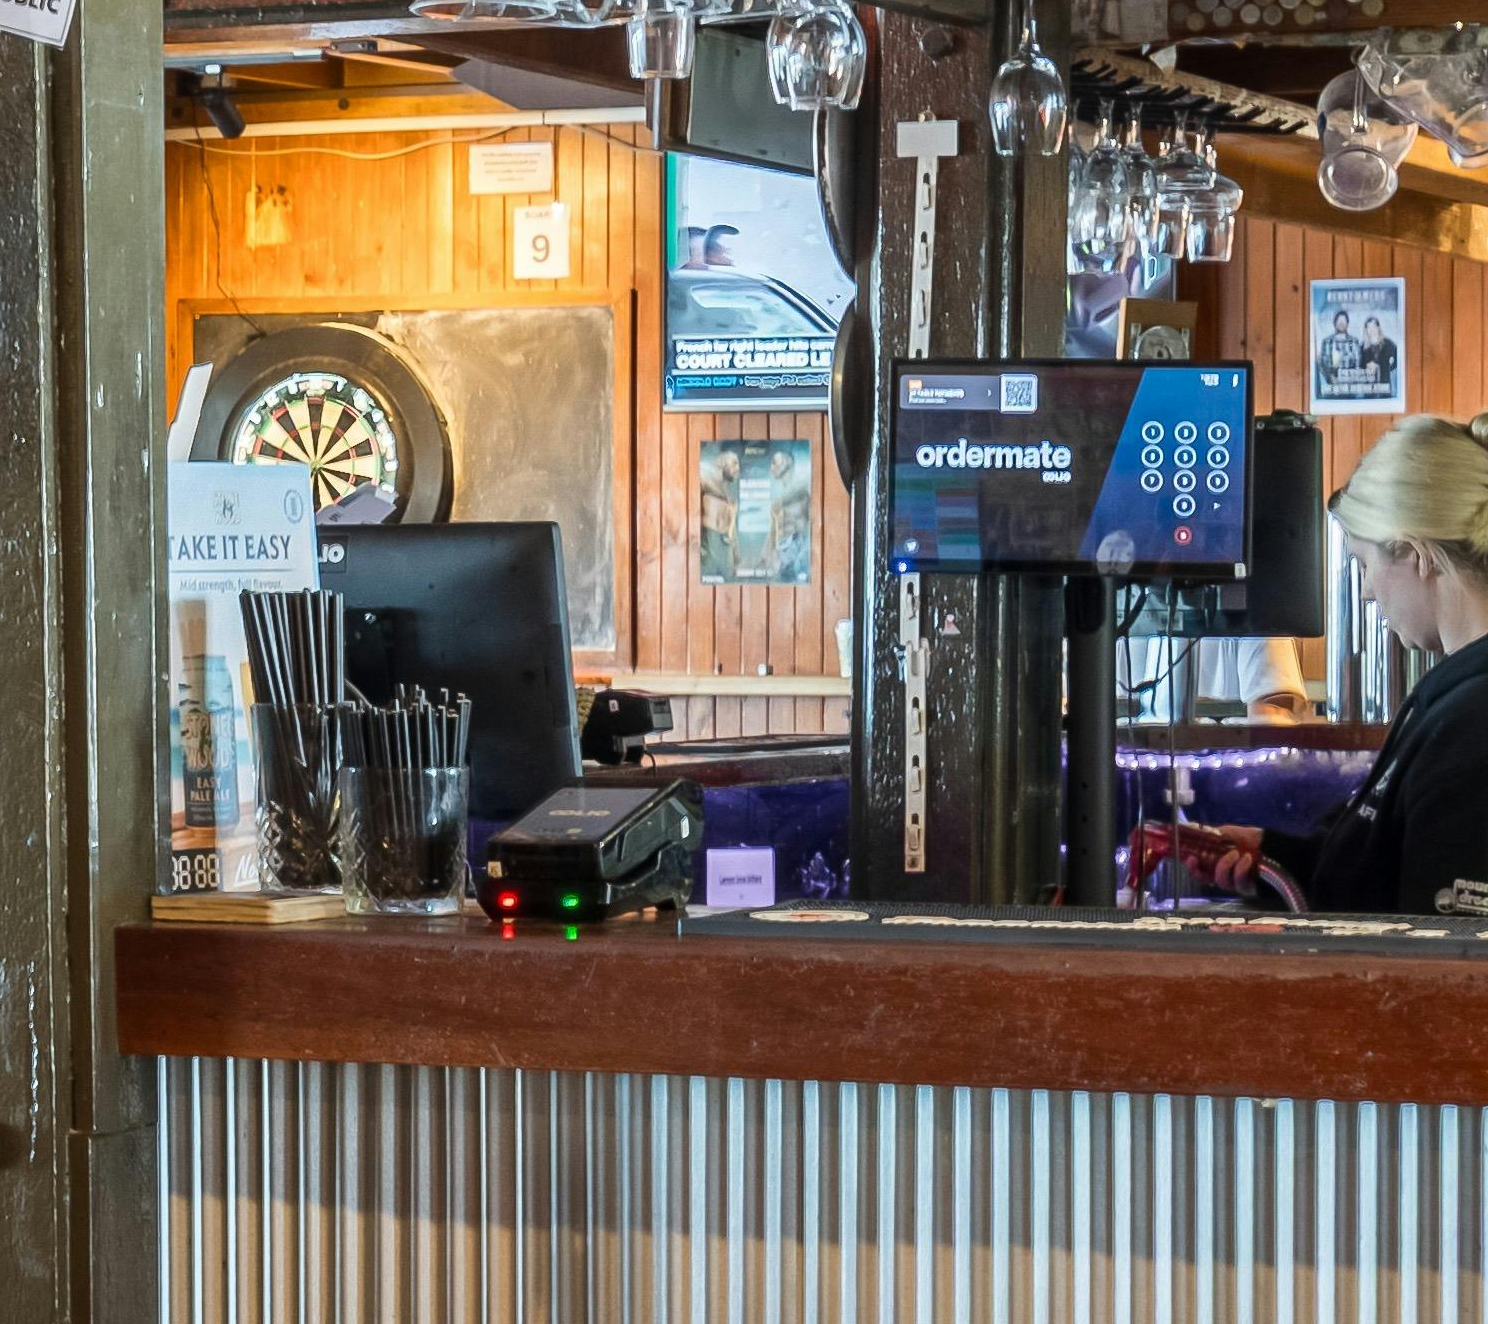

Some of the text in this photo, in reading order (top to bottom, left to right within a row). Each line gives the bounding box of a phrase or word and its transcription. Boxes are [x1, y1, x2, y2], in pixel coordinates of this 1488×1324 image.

[532, 234, 550, 263] 9
[676, 352, 733, 370] COURT
[733, 351, 810, 369] CLEARED
[916, 437, 1073, 469] ordermate
[222, 535, 239, 560] IT
[245, 534, 292, 560] EASY
[180, 579, 197, 592] Mid
[198, 579, 237, 594] strength,
[238, 579, 253, 591] full
[197, 777, 222, 789] EASY
[190, 790, 211, 802] PALE
